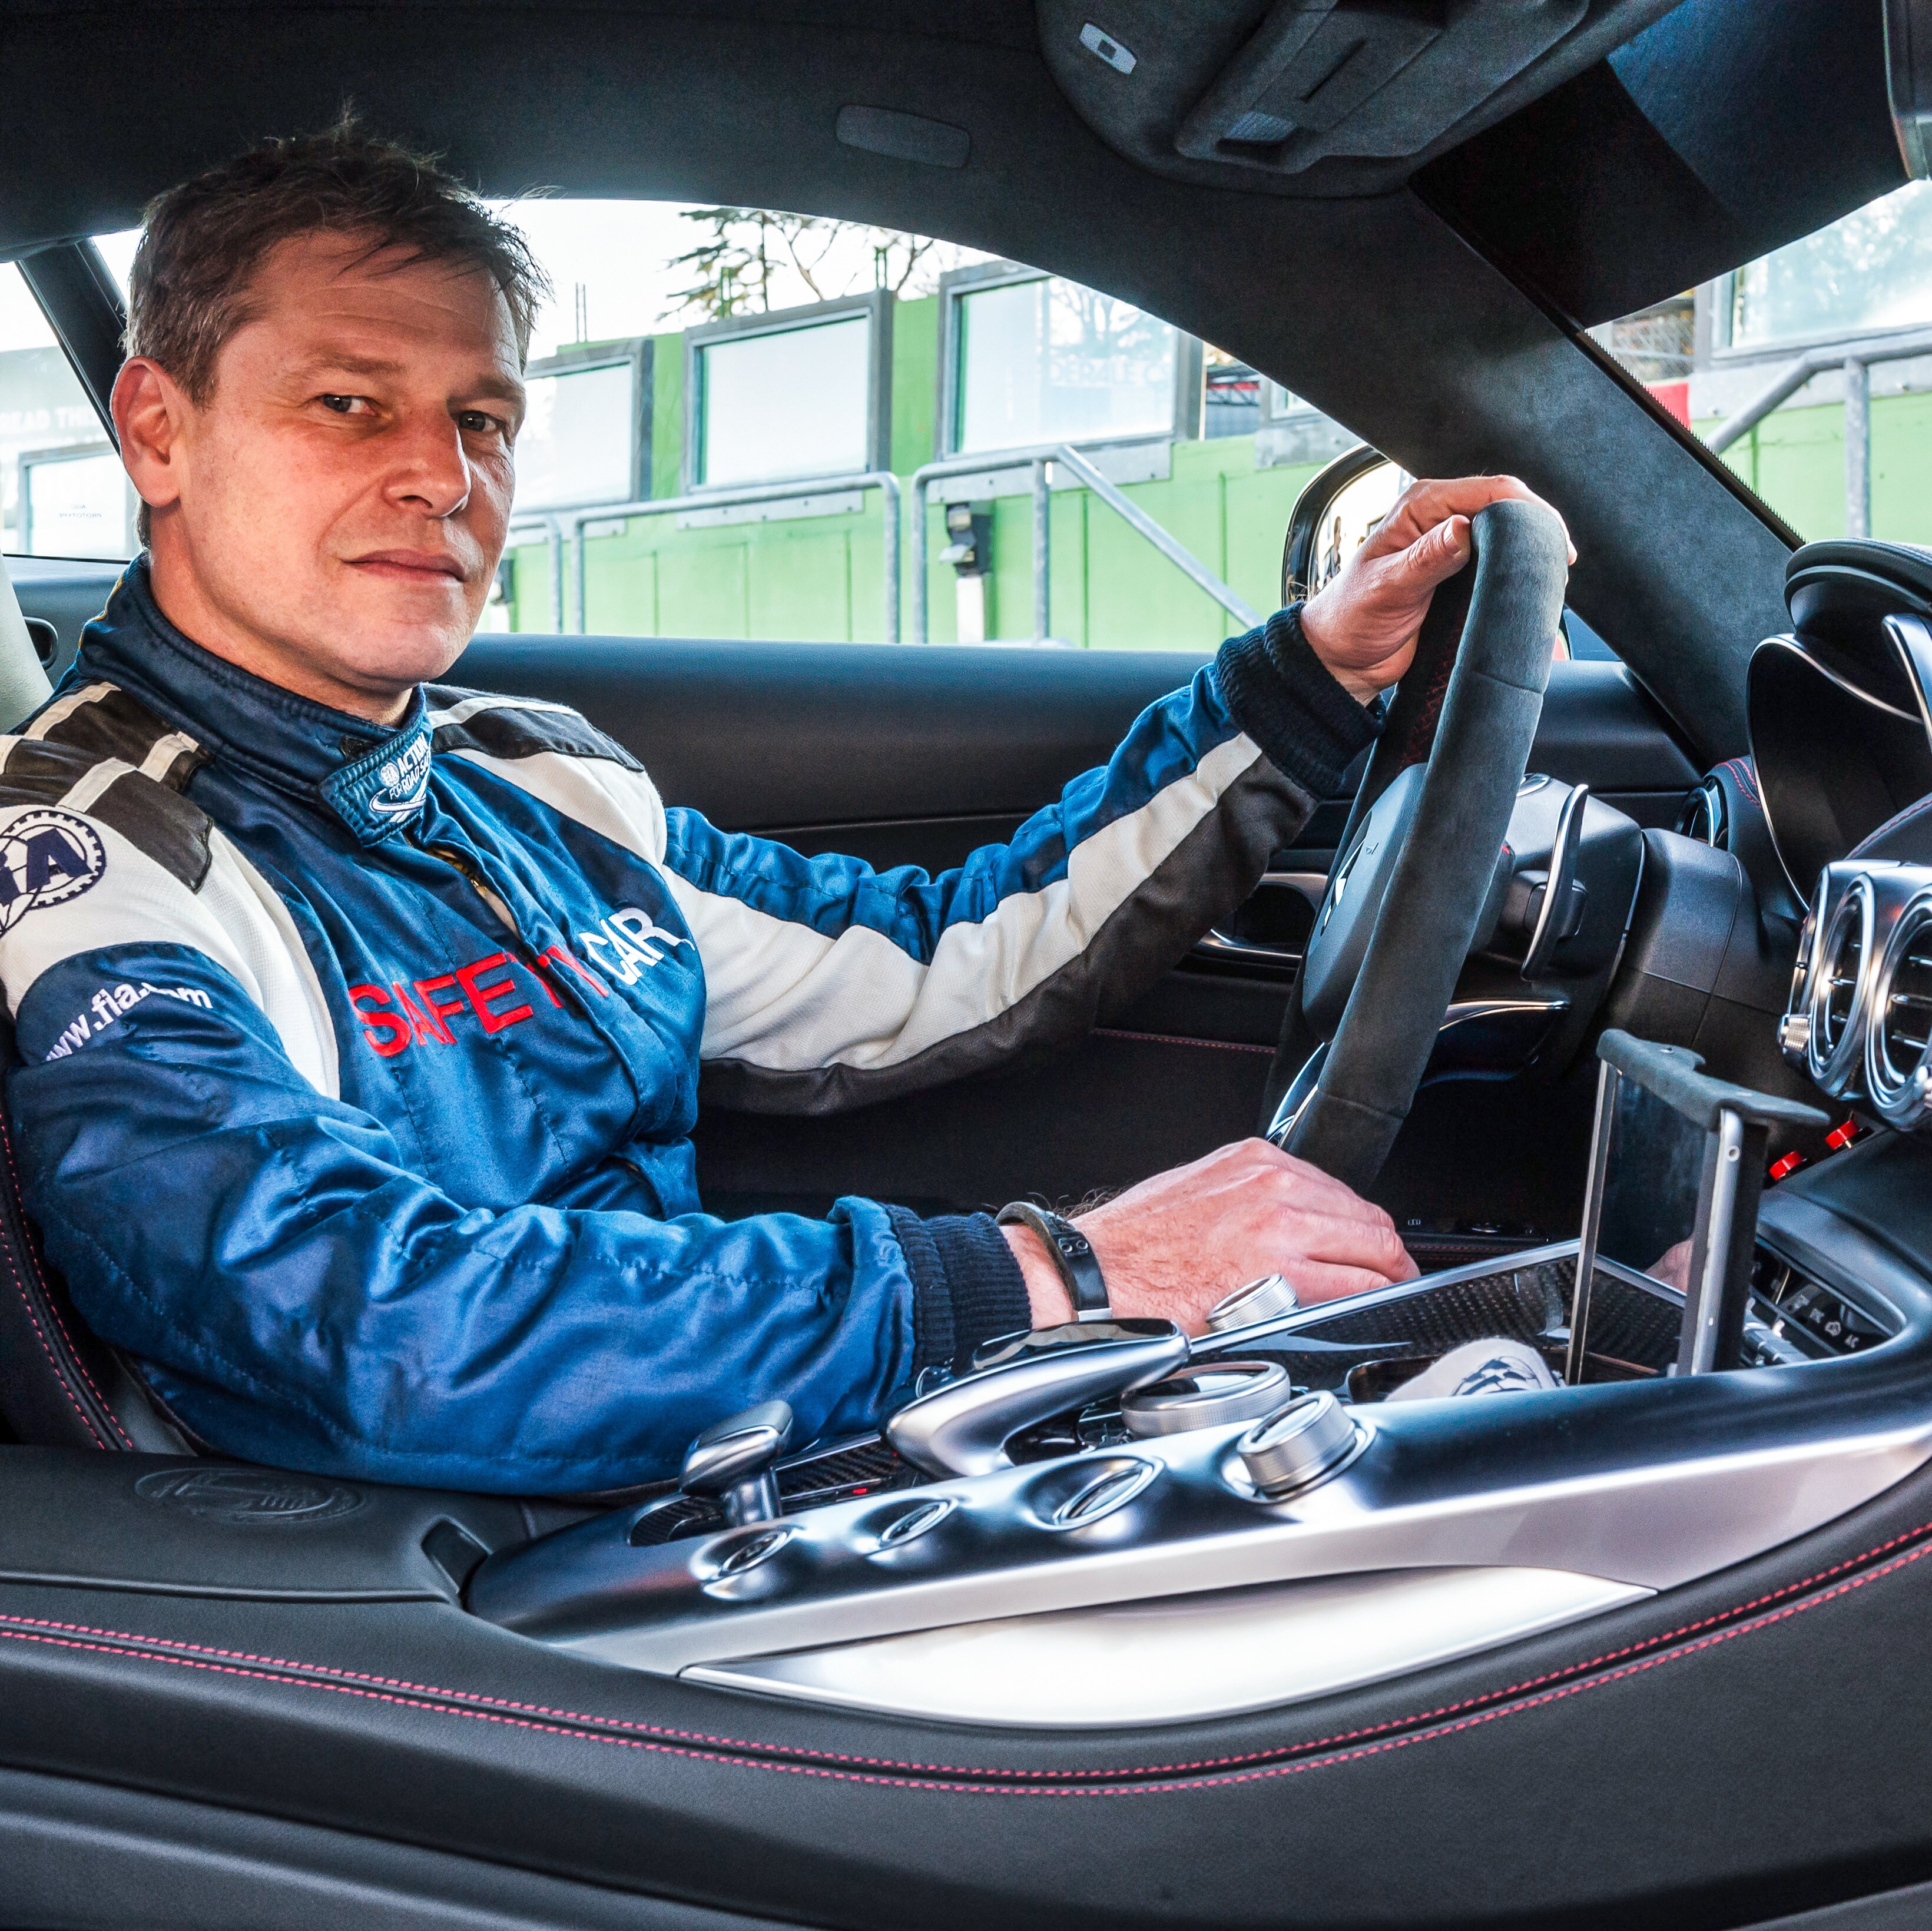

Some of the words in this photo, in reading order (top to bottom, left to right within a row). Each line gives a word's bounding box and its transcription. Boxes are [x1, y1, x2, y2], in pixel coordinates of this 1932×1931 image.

[397, 732, 429, 778] ACTION
[389, 783, 403, 800] FOR
[401, 765, 420, 794] ROAD
[579, 907, 695, 986] CAR
